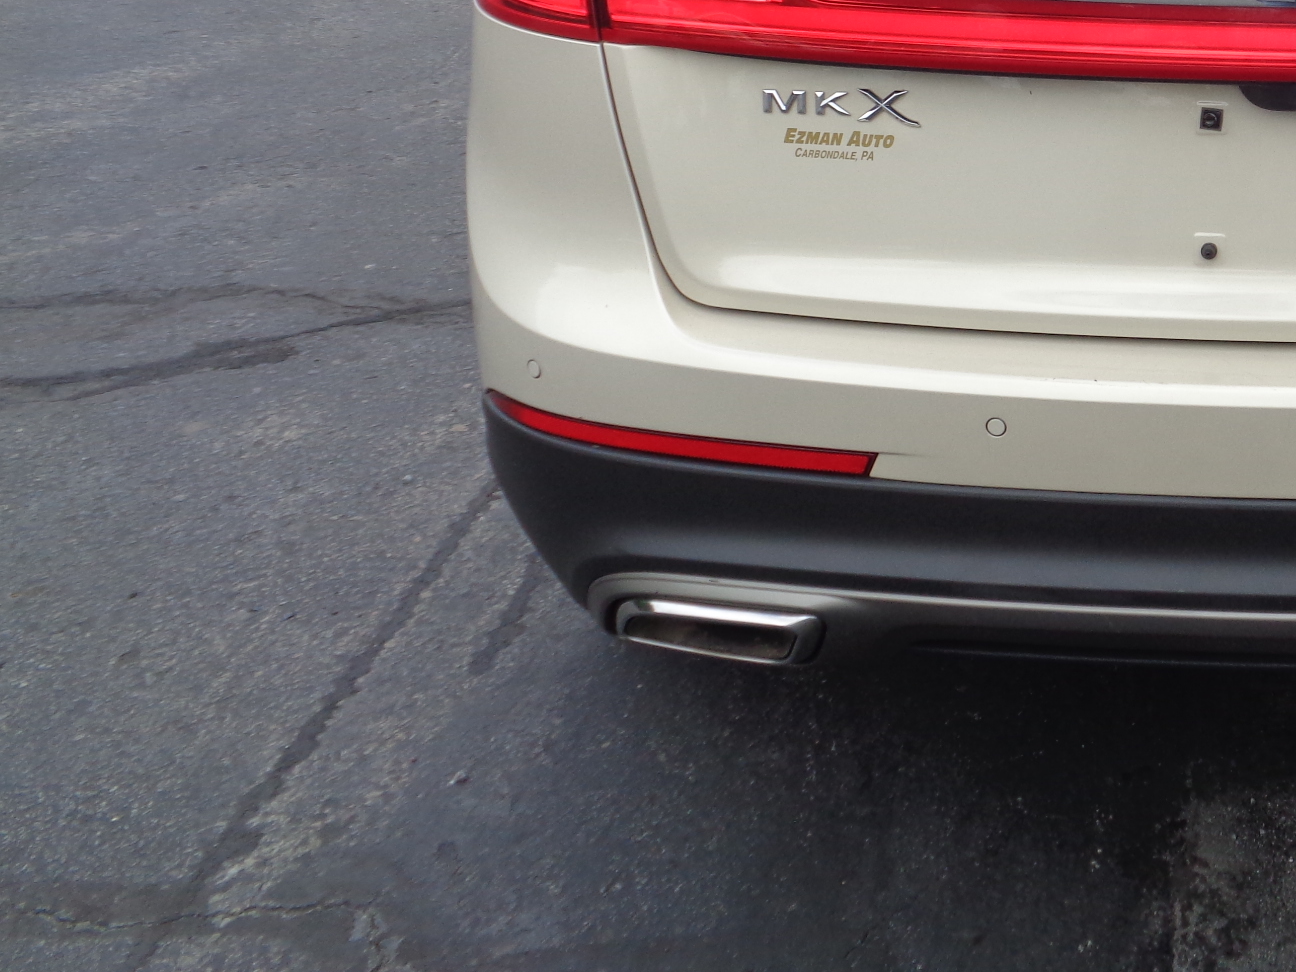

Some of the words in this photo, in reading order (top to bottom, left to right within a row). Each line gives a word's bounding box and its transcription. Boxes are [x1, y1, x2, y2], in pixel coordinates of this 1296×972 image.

[762, 88, 921, 128] MKX
[784, 128, 843, 146] EZMAN
[847, 130, 895, 149] AUTO
[861, 150, 874, 161] PA
